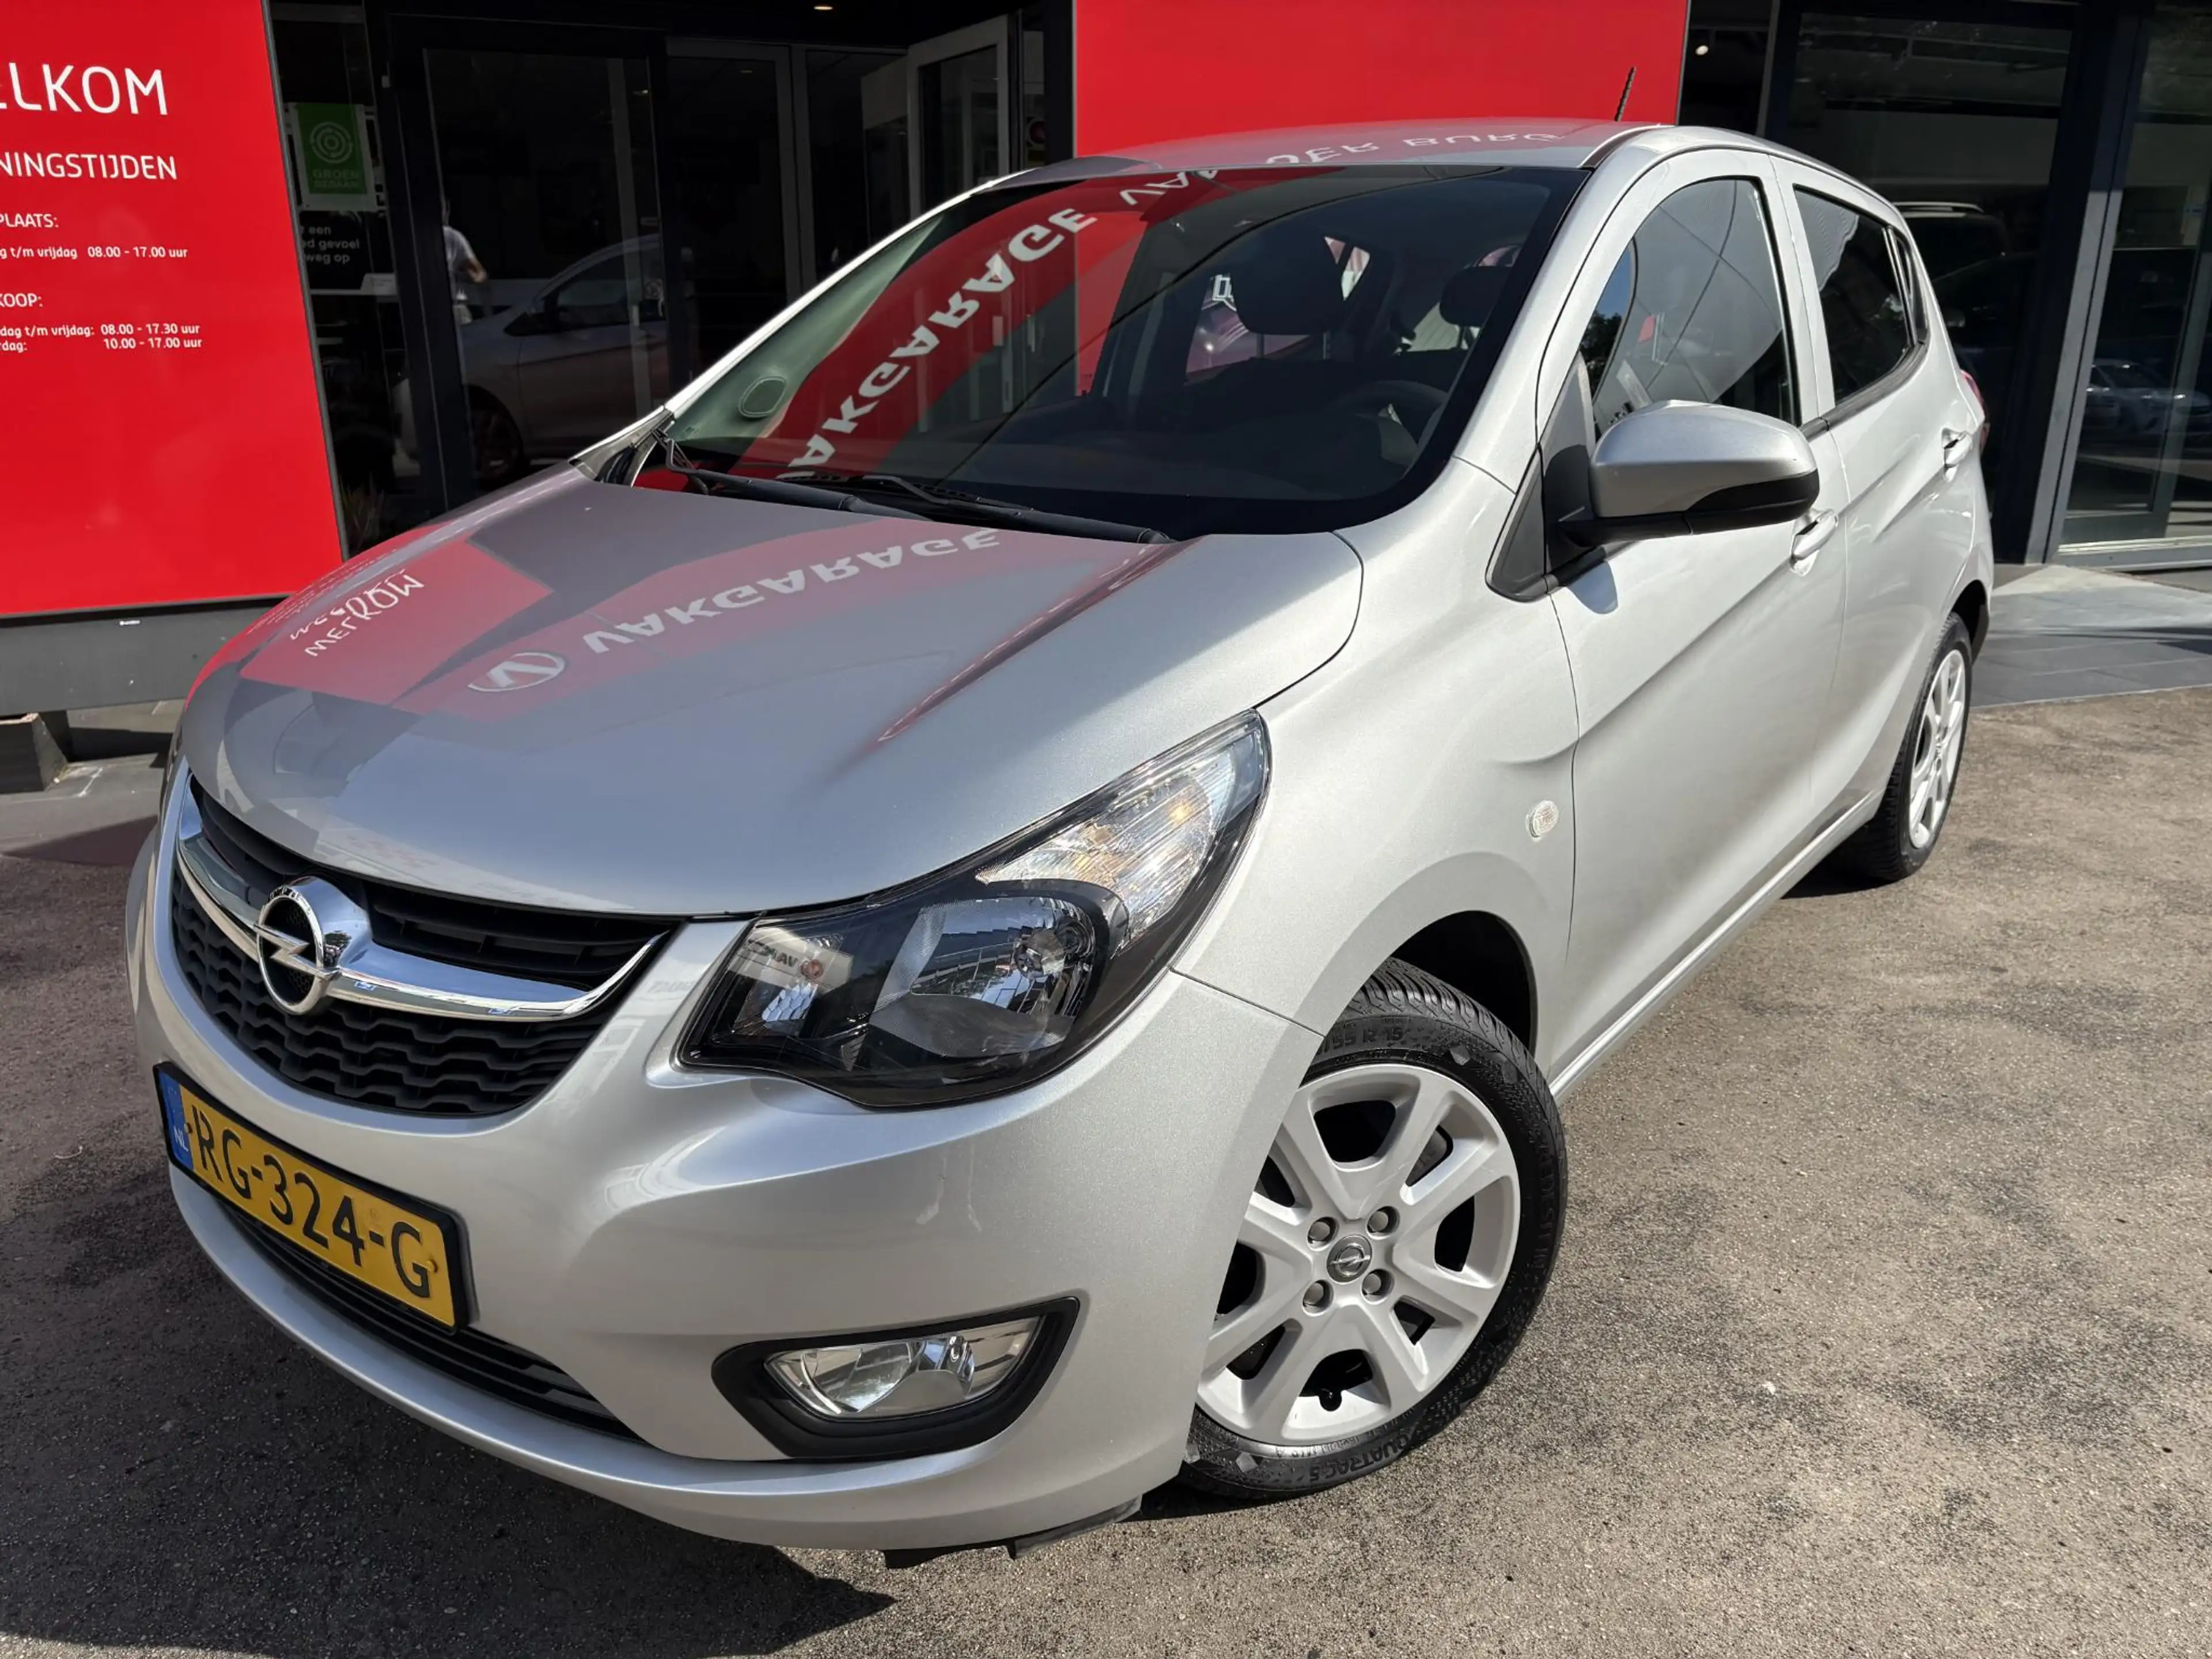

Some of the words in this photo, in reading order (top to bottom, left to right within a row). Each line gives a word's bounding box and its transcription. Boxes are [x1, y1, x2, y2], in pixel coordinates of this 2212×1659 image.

[0, 62, 168, 115] LKOM
[319, 238, 359, 251] gevoel
[10, 246, 35, 259] t/m
[37, 247, 78, 260] vrijdag
[88, 246, 121, 257] 08.00
[132, 246, 166, 257] 17.00
[169, 248, 188, 257] uur
[334, 254, 351, 265] op
[24, 325, 48, 337] t/m
[51, 325, 94, 338] vrijdag:
[100, 323, 134, 335] 08.00
[145, 323, 178, 334] 17.30
[181, 324, 200, 334] uur
[103, 338, 136, 349] 10.00
[147, 337, 180, 349] 17.00
[183, 339, 202, 348] uur
[1362, 1027, 1377, 1044] R
[1382, 1026, 1404, 1041] 15
[173, 1126, 189, 1152] NL
[191, 1105, 430, 1298] RG-324-G
[1324, 1434, 1410, 1479] QUATRAC
